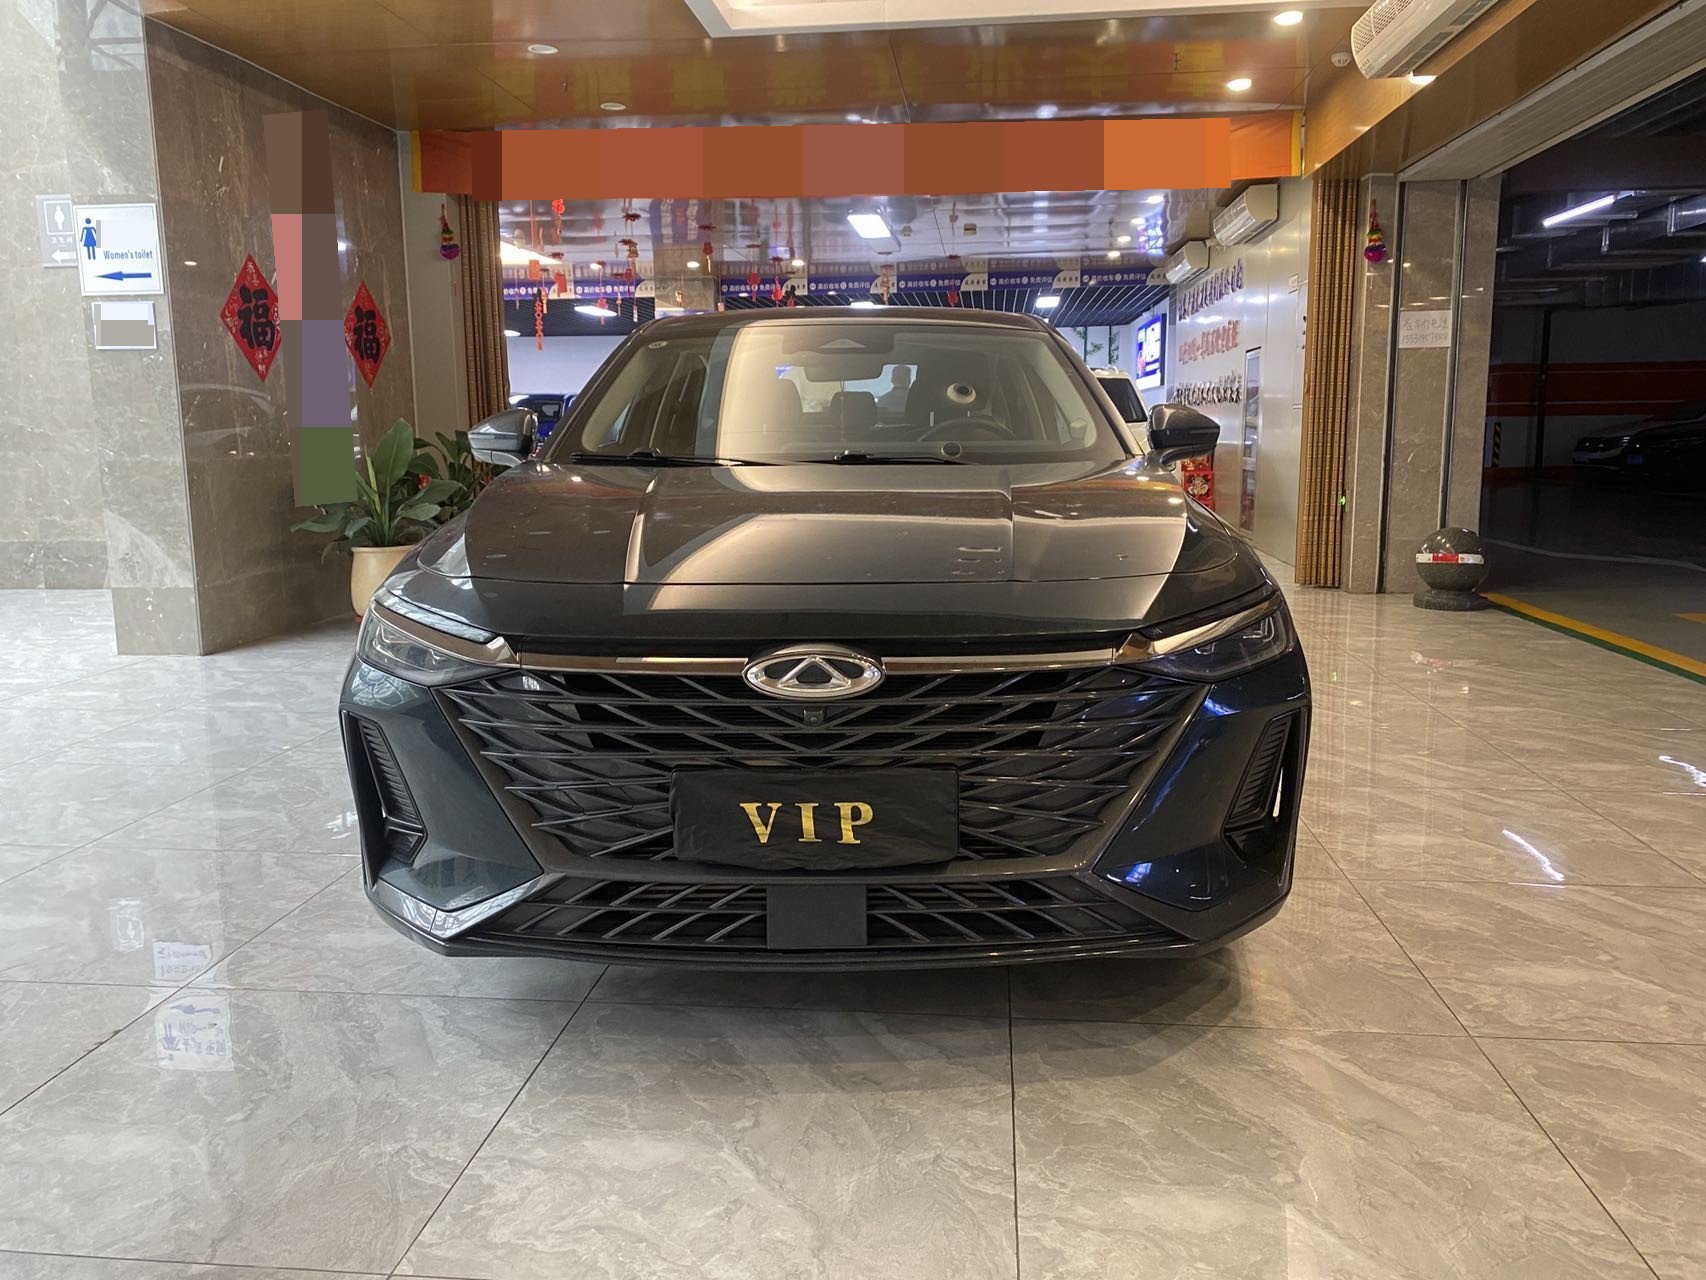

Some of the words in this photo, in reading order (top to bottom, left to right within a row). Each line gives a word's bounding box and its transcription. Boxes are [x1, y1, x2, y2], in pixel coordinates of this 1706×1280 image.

[103, 250, 134, 260] Women's
[135, 250, 153, 259] toilet
[237, 283, 276, 351] 福
[353, 305, 381, 364] 福
[739, 802, 874, 844] VIP
